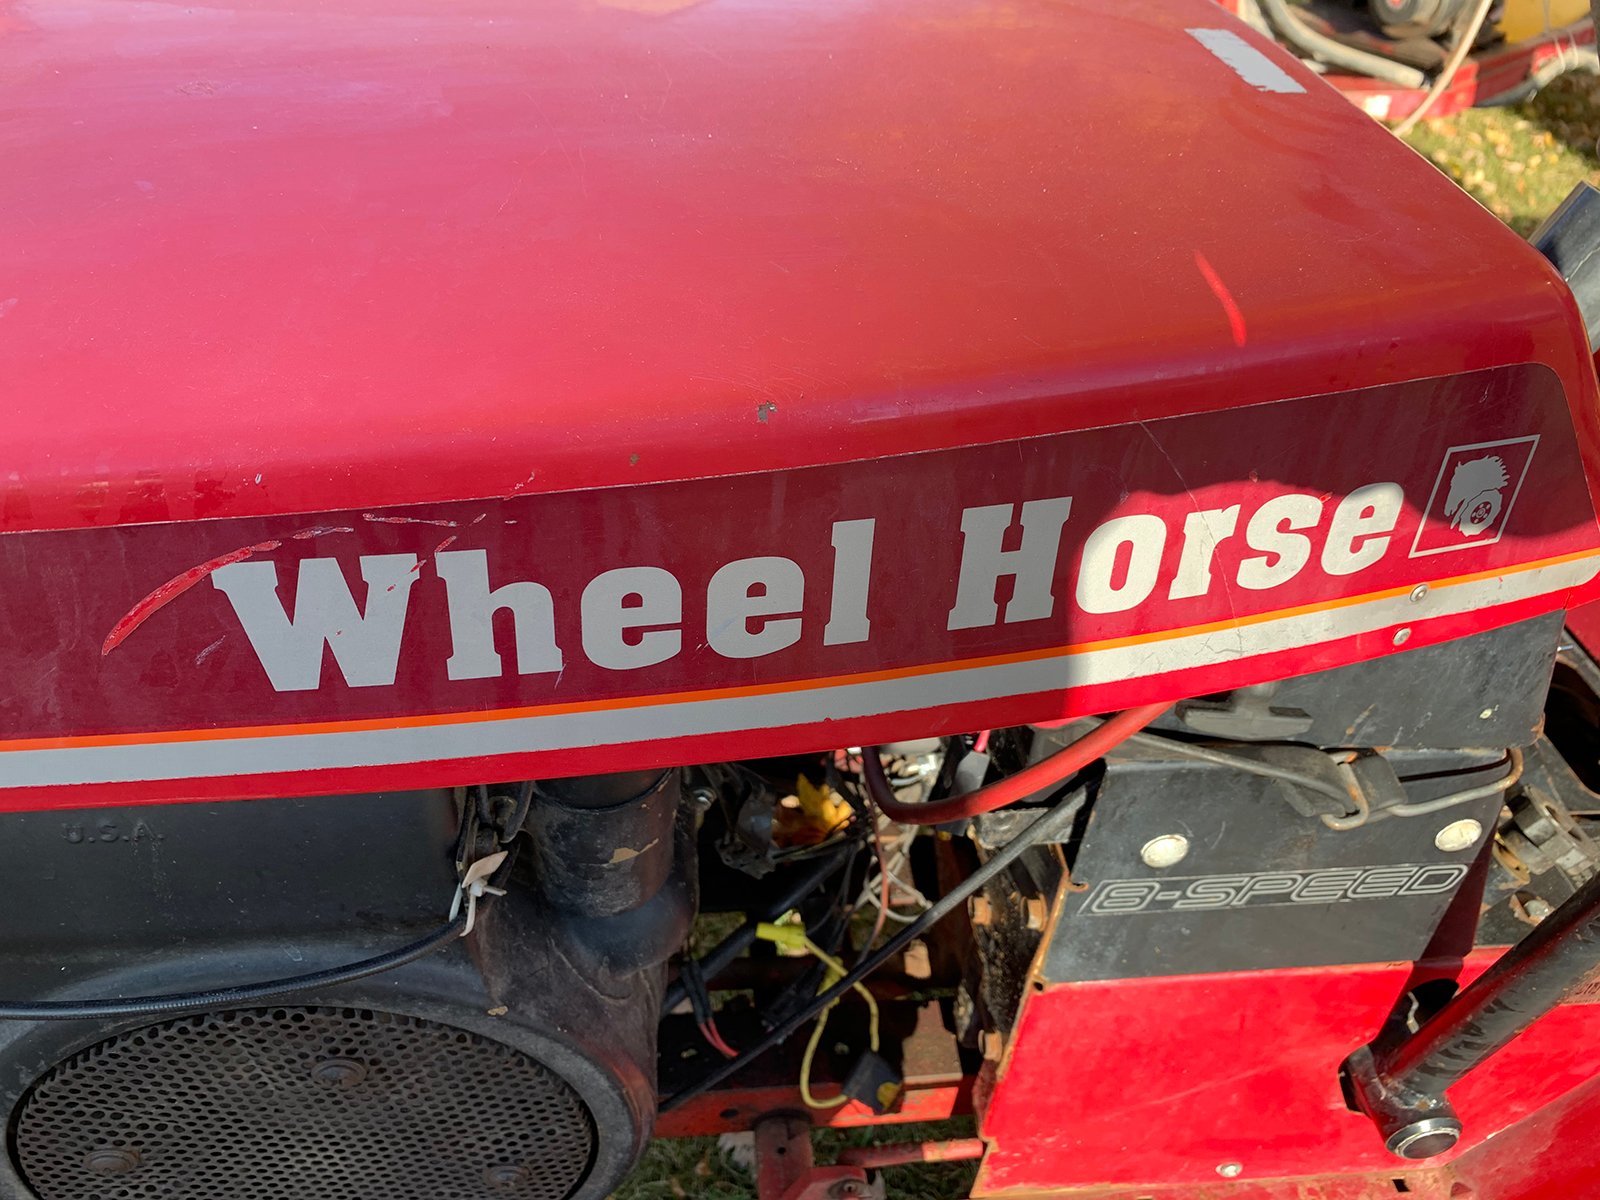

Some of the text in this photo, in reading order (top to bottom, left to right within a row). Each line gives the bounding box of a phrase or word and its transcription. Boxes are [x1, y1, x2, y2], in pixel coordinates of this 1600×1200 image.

[211, 482, 1404, 691] Wheel Horse
[64, 820, 165, 844] U.S.A.
[1091, 864, 1468, 913] 8-SPEED
